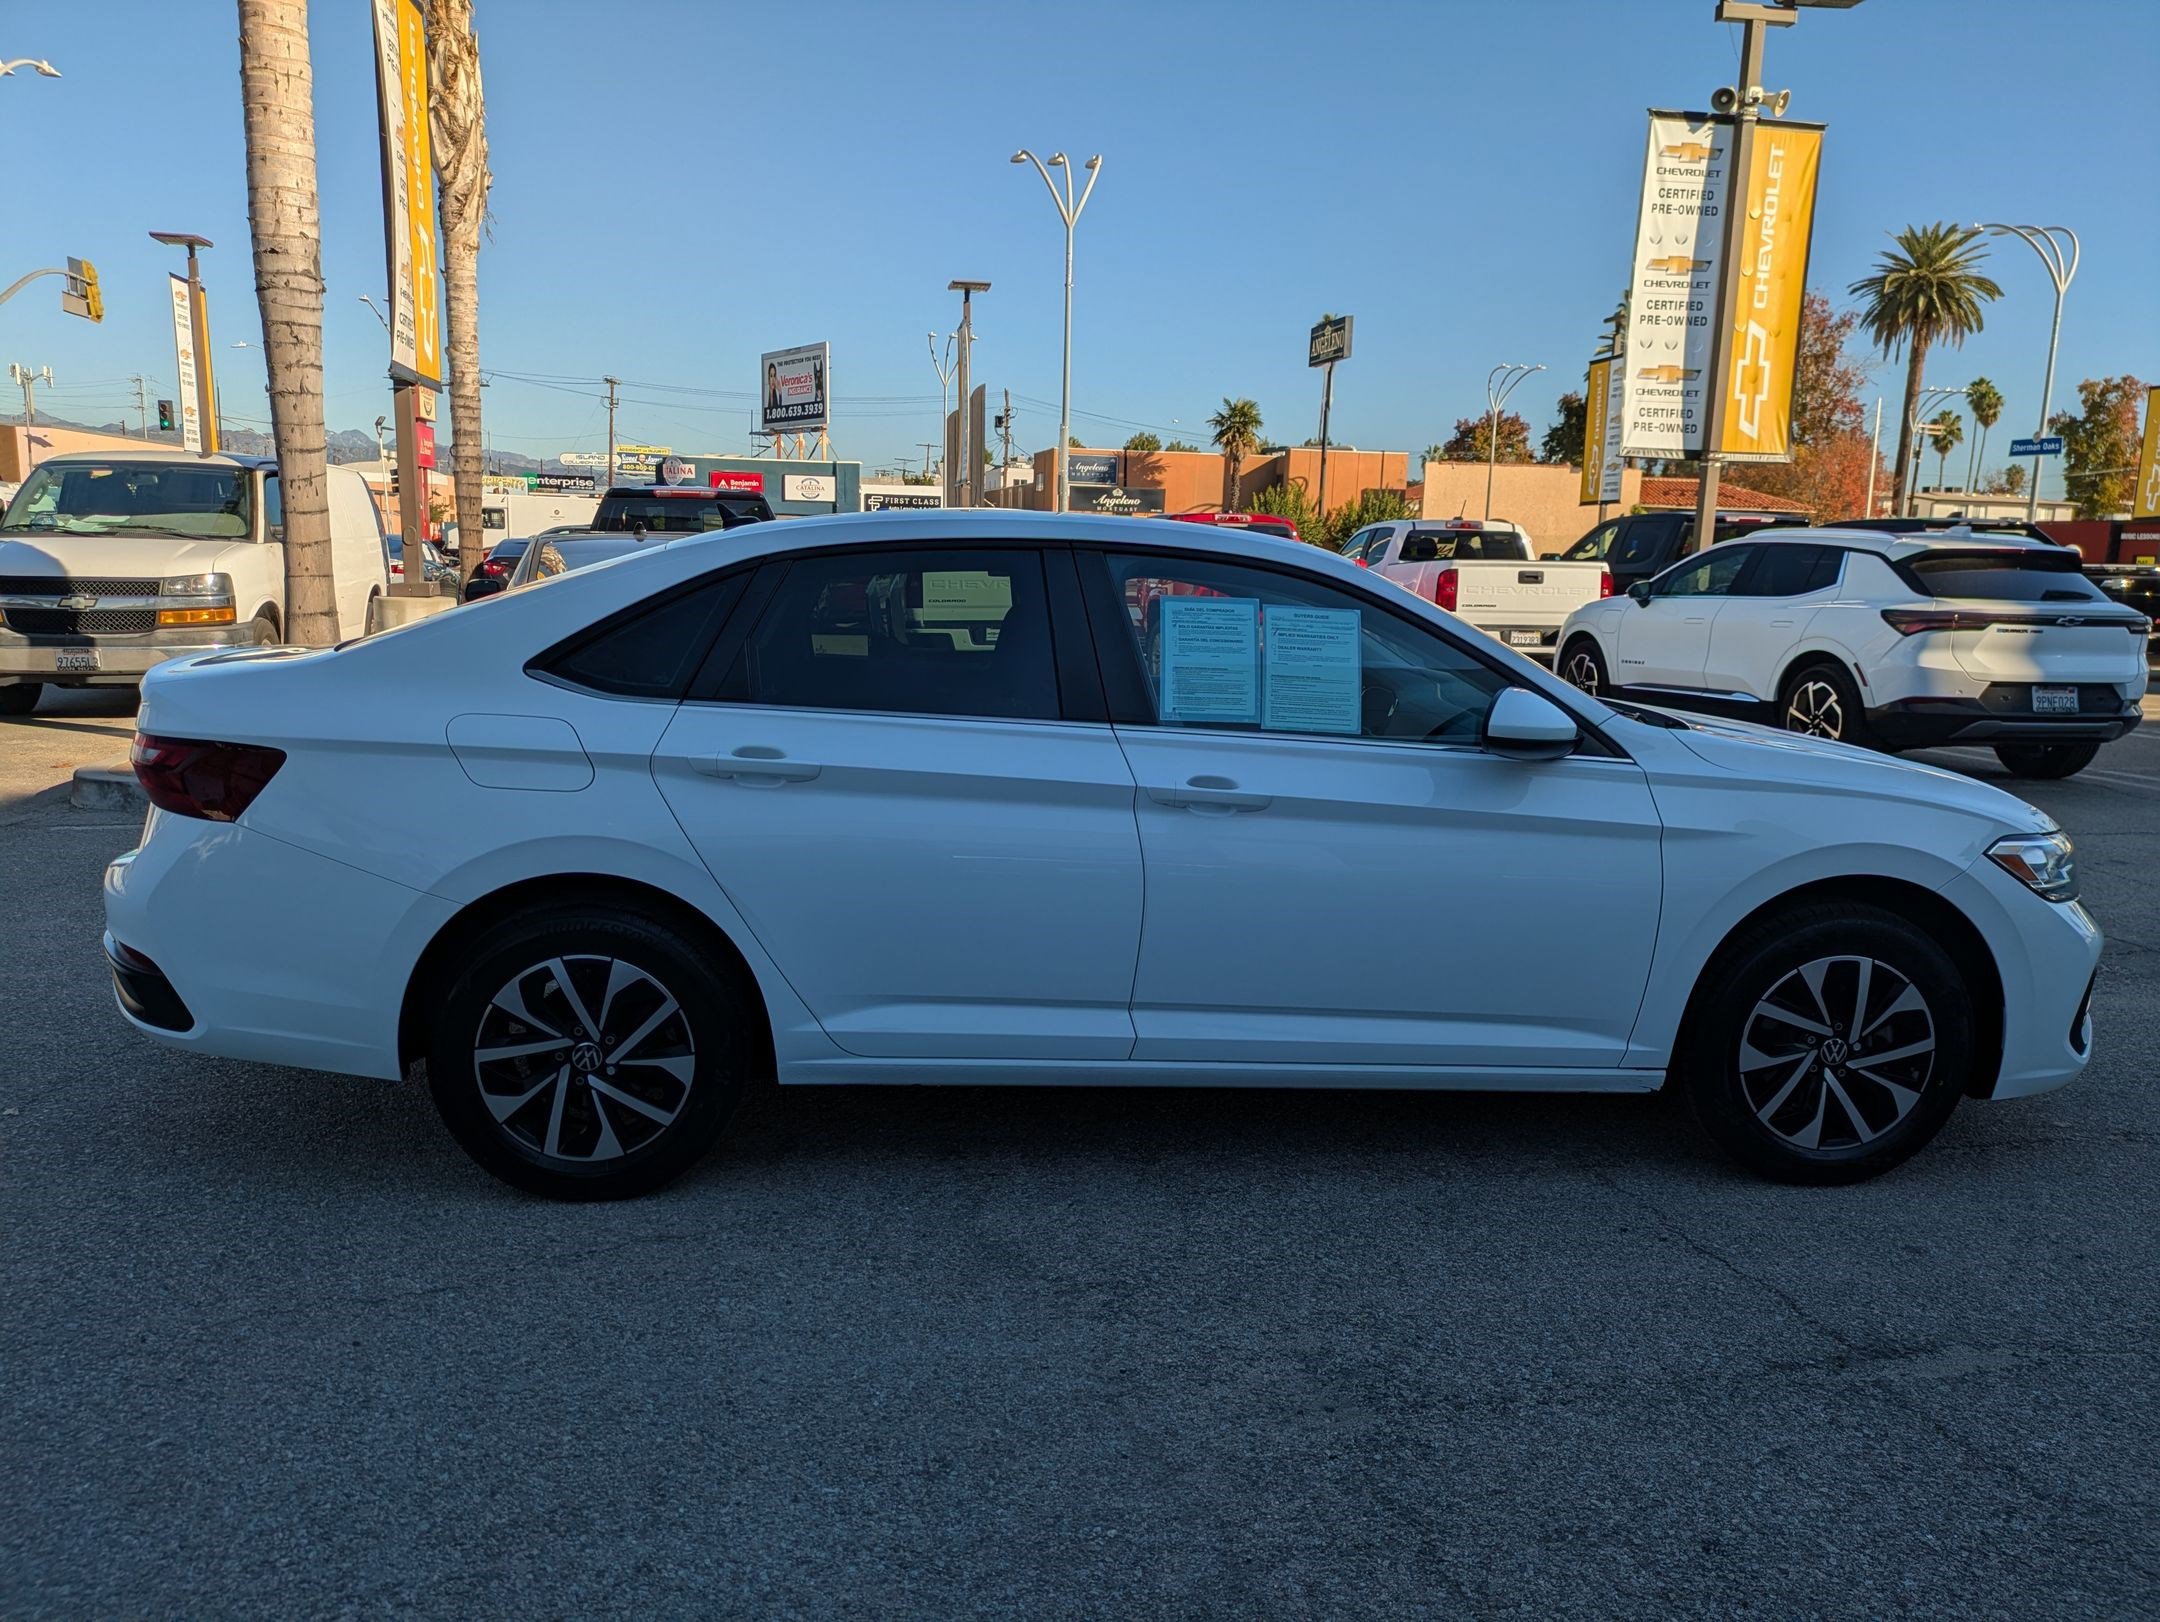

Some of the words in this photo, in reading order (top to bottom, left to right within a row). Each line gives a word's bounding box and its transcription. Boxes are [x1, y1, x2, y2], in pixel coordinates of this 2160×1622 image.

[1656, 167, 1721, 178] CHEVROLET
[1658, 187, 1714, 201] CERTIFIED
[1651, 203, 1719, 216] PRE-OWNED
[1753, 143, 1785, 310] CHEVROLET
[1643, 280, 1711, 289] CHEVROLET
[1646, 299, 1704, 311] CERTIFIED
[1639, 314, 1708, 327] PRE-OWNED
[780, 372, 813, 387] Veronica's
[788, 386, 812, 395] INSURANCE
[1635, 388, 1700, 398] CHEVROLET
[766, 403, 823, 420] 1.800.639.3939
[1638, 407, 1694, 419] CERTIFIED
[1633, 421, 1698, 434] PRE-OWNED
[2012, 444, 2041, 452] Sherman
[2042, 442, 2060, 451] Oaks
[1070, 462, 1109, 472] Angeleno
[528, 476, 594, 490] enterprise
[730, 479, 760, 487] Benjamin
[885, 497, 910, 505] FIRST
[912, 498, 940, 506] CLASS
[1092, 494, 1142, 507] Angeleno
[1464, 585, 1597, 597] CHEVROLET
